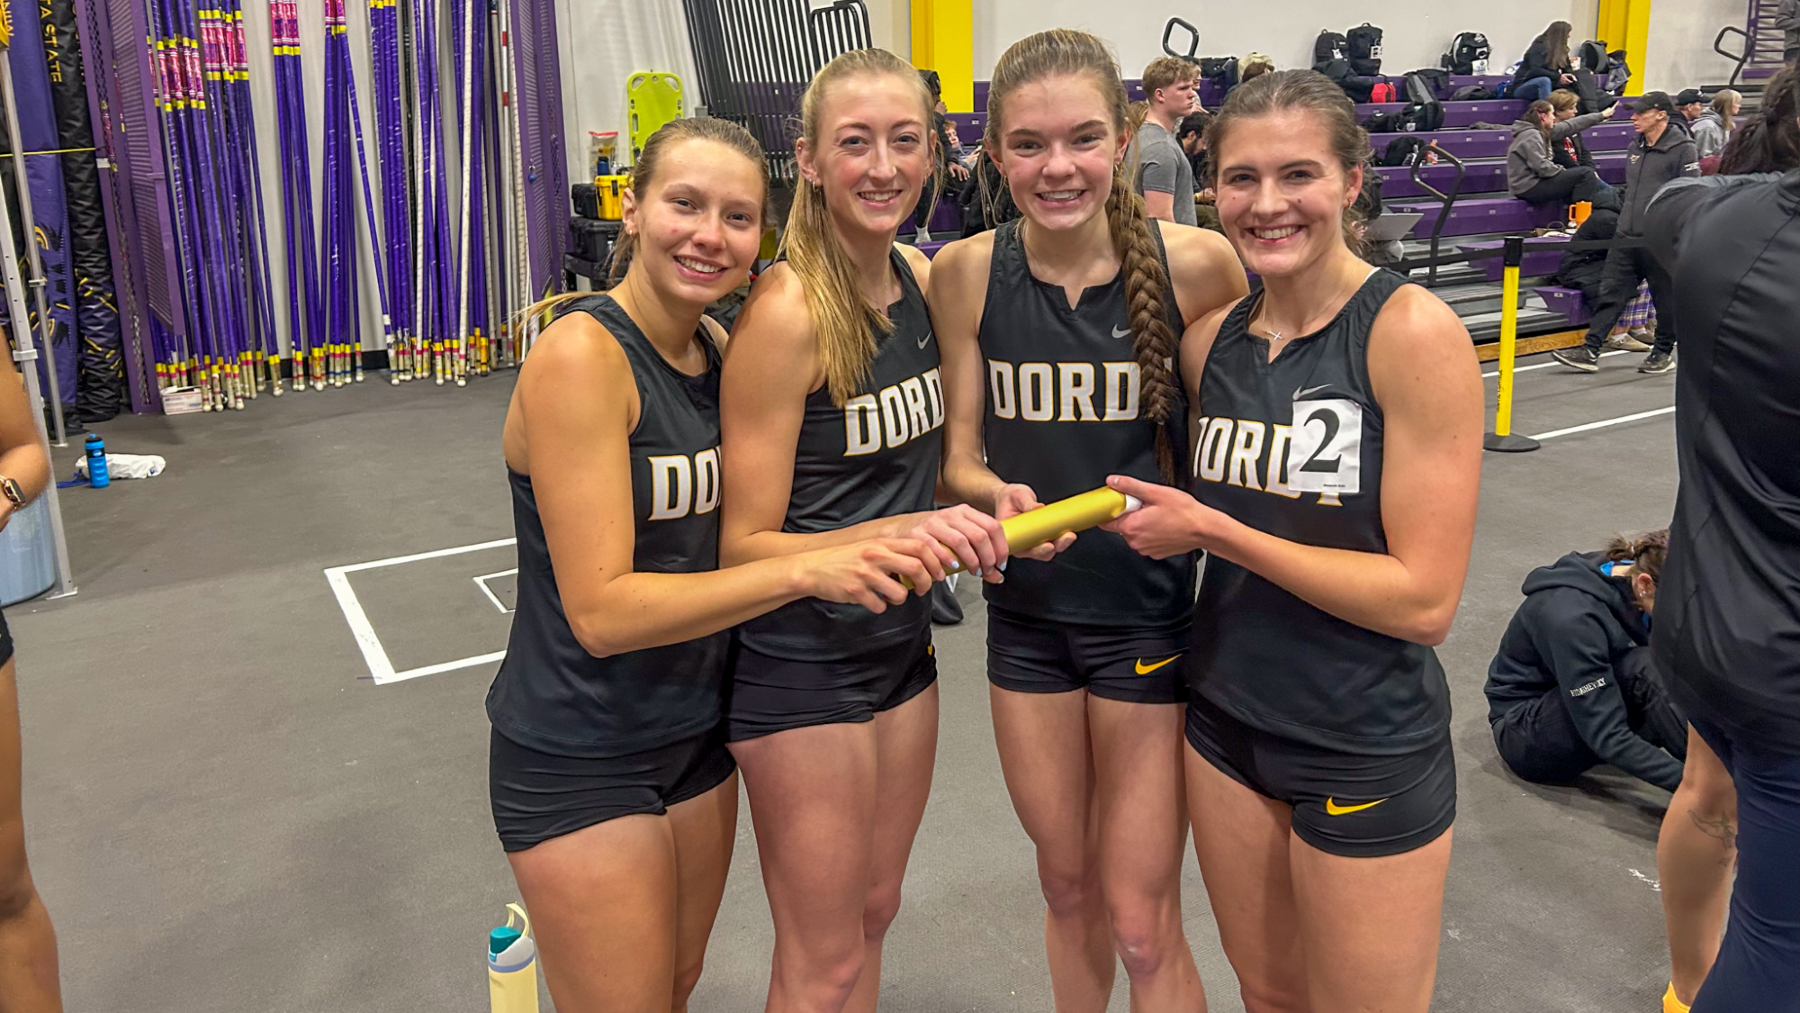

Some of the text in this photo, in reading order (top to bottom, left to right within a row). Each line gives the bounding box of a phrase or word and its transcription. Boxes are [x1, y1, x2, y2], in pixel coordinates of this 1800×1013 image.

[44, 24, 62, 82] STATE
[843, 365, 945, 457] DORD
[988, 357, 1172, 422] DORD
[1193, 417, 1343, 506] ORD
[1299, 407, 1342, 473] 2
[648, 444, 721, 521] DO
